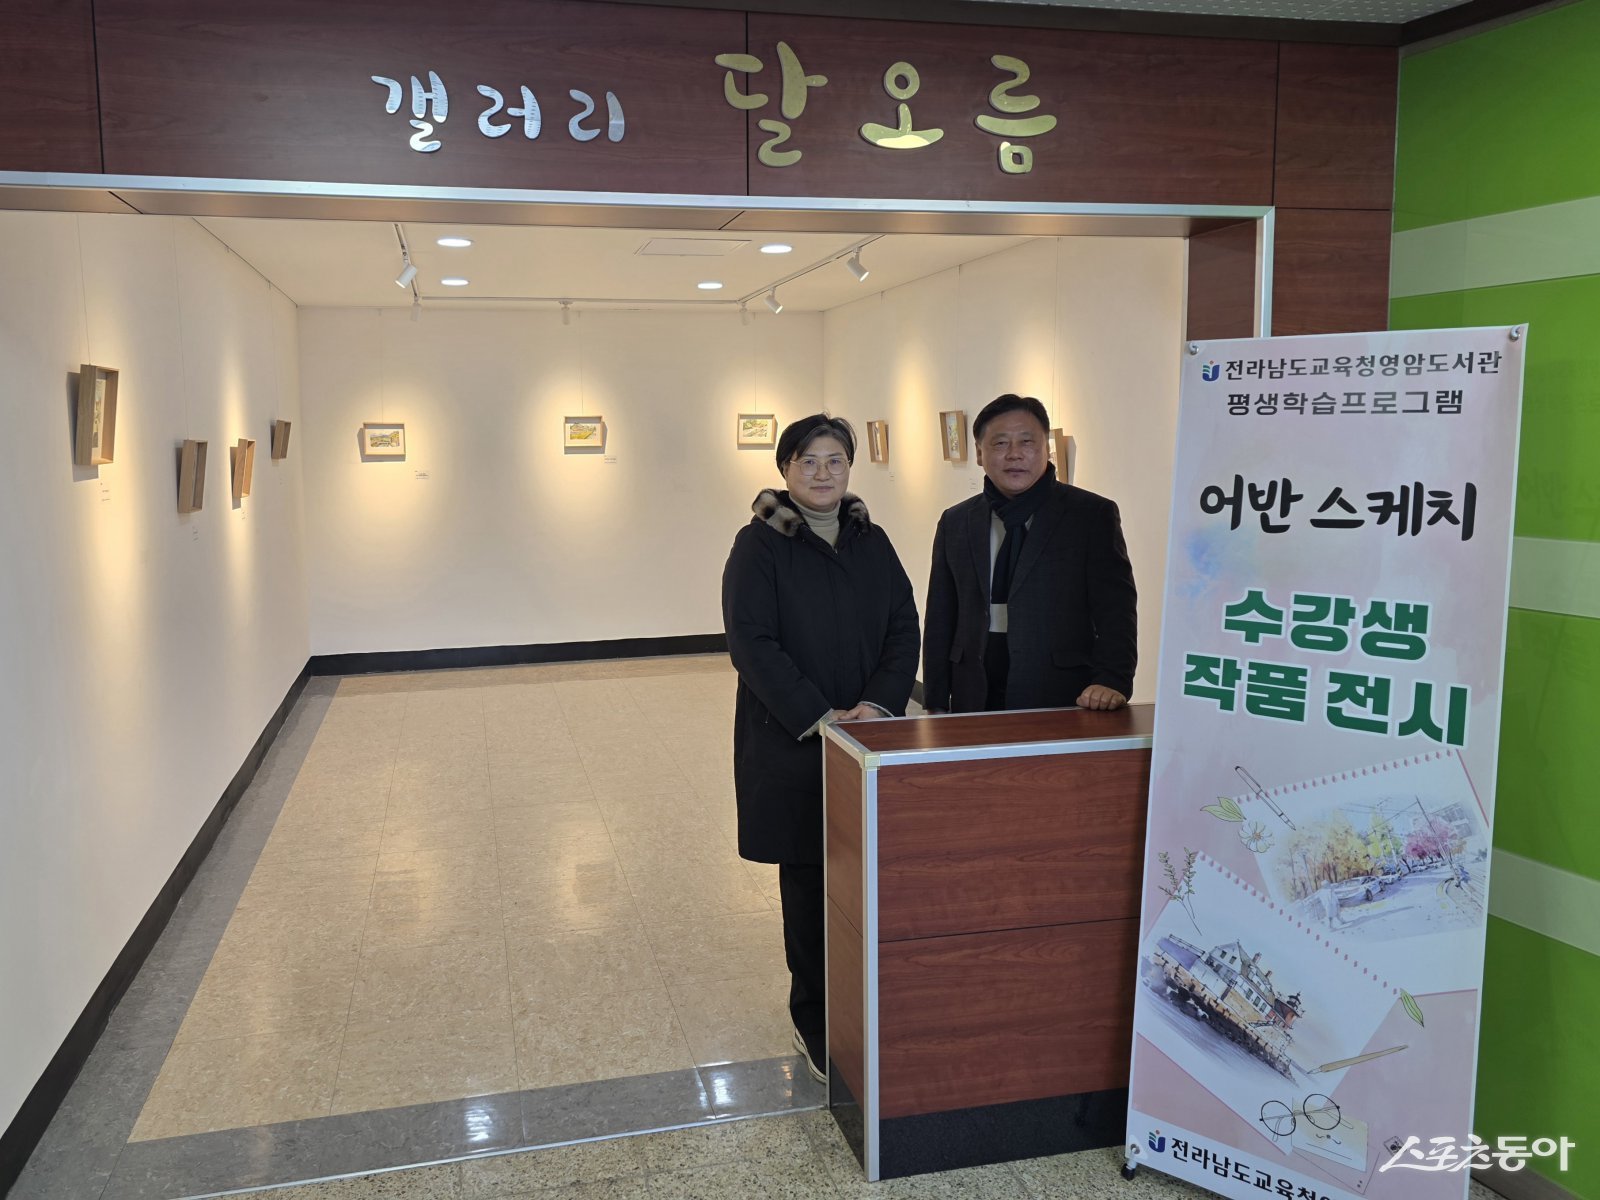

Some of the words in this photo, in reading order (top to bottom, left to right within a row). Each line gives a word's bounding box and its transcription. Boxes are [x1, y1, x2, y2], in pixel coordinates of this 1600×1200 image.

[370, 69, 626, 153] 갤러리
[714, 41, 1058, 174] 달오름
[1225, 350, 1502, 380] 전라남도교육청영암도서관
[1227, 389, 1464, 416] 평생학습프로그램
[1199, 474, 1304, 534] 어반
[1309, 481, 1477, 541] 스케치
[1223, 589, 1430, 661] 수강생
[1183, 653, 1309, 723] 작품
[1326, 671, 1468, 747] 전시
